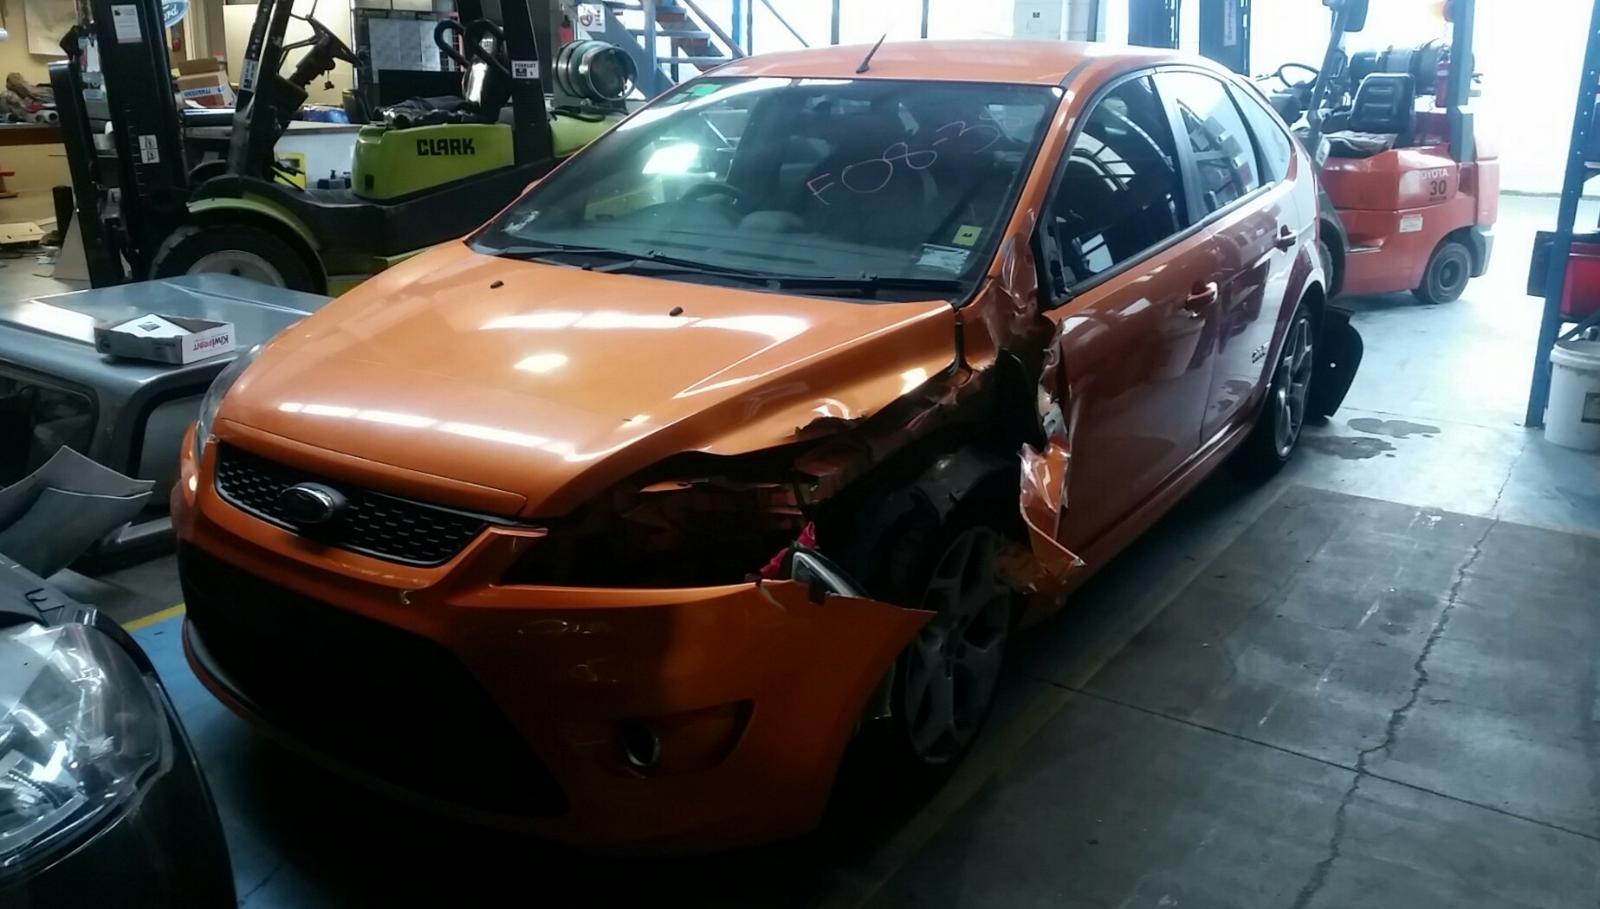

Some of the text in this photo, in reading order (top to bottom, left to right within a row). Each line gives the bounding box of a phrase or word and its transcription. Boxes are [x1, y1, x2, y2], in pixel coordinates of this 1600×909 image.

[416, 137, 476, 156] CLARK
[1419, 168, 1449, 180] OYOTA
[1430, 179, 1447, 196] 30
